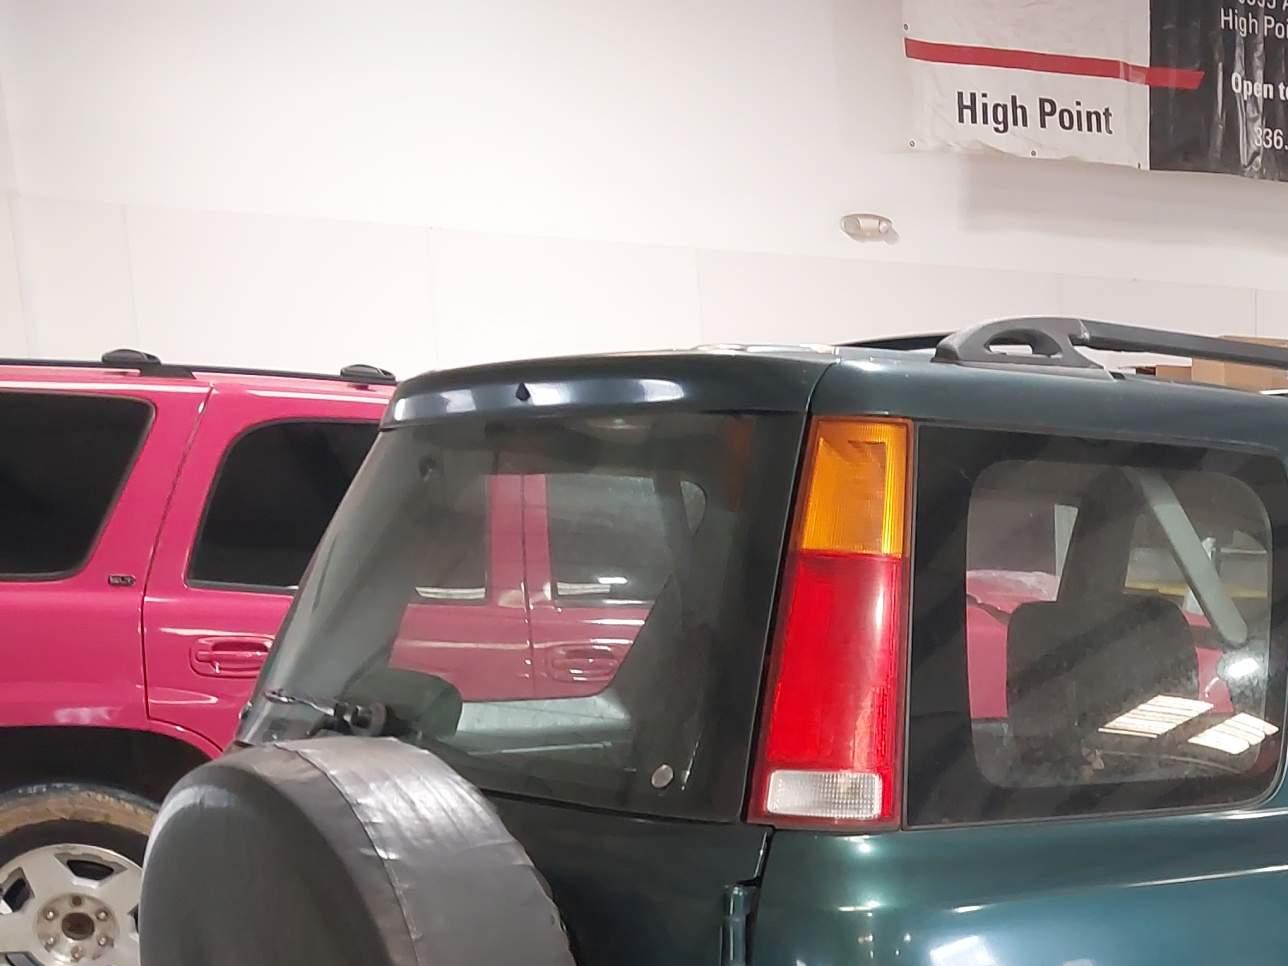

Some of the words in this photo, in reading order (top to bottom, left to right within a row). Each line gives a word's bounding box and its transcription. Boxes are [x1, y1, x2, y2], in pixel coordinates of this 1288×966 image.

[1220, 7, 1258, 37] High
[1231, 71, 1274, 100] Open
[957, 91, 1028, 134] High
[1038, 97, 1113, 135] Point
